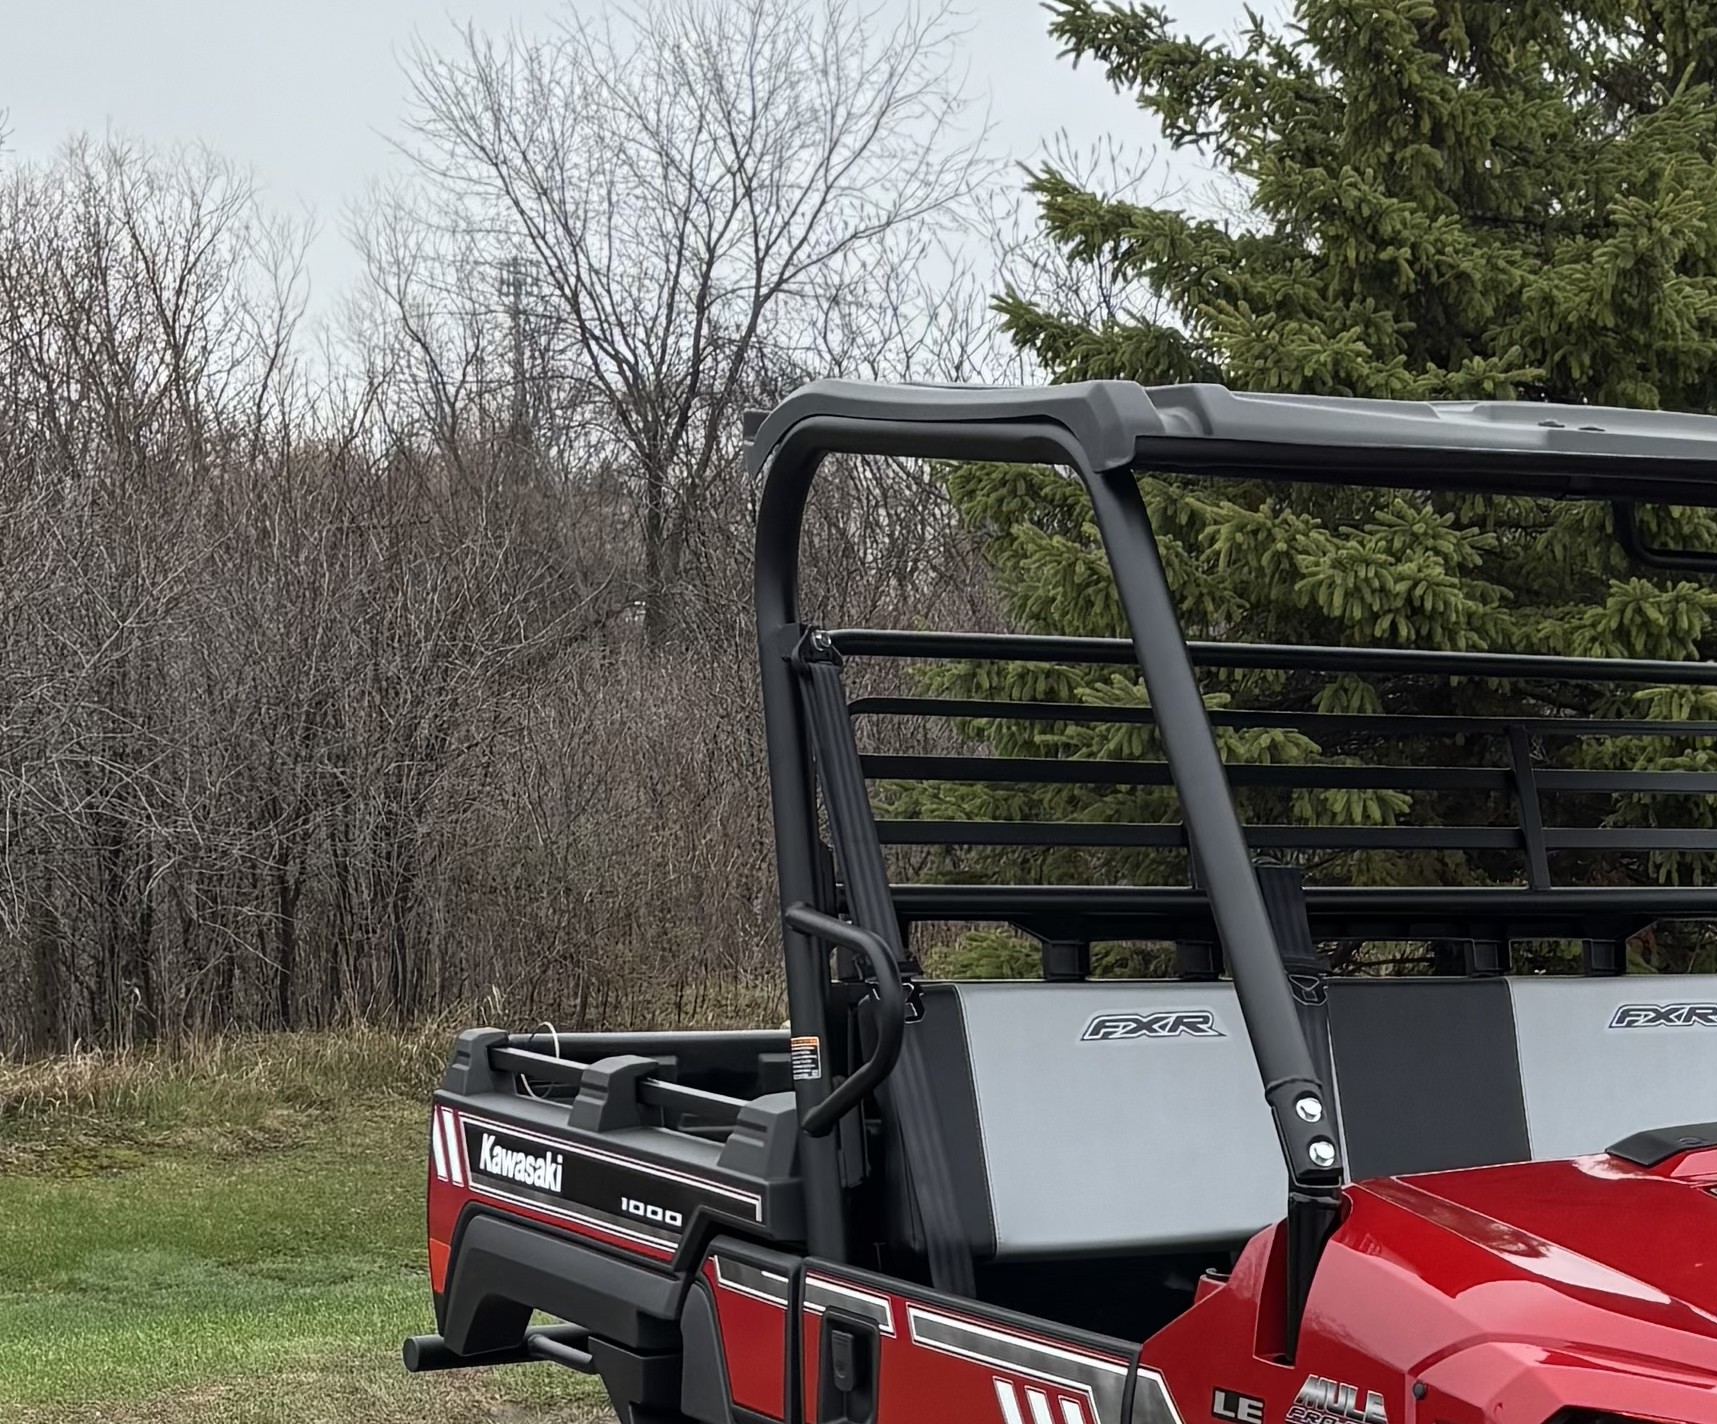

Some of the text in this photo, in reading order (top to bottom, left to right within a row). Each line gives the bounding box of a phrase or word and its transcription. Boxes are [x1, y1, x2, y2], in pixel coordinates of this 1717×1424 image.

[1080, 1010, 1227, 1041] FXR
[479, 1133, 563, 1193] Kawasaki
[621, 1197, 683, 1227] 1000
[1213, 1390, 1264, 1424] LE
